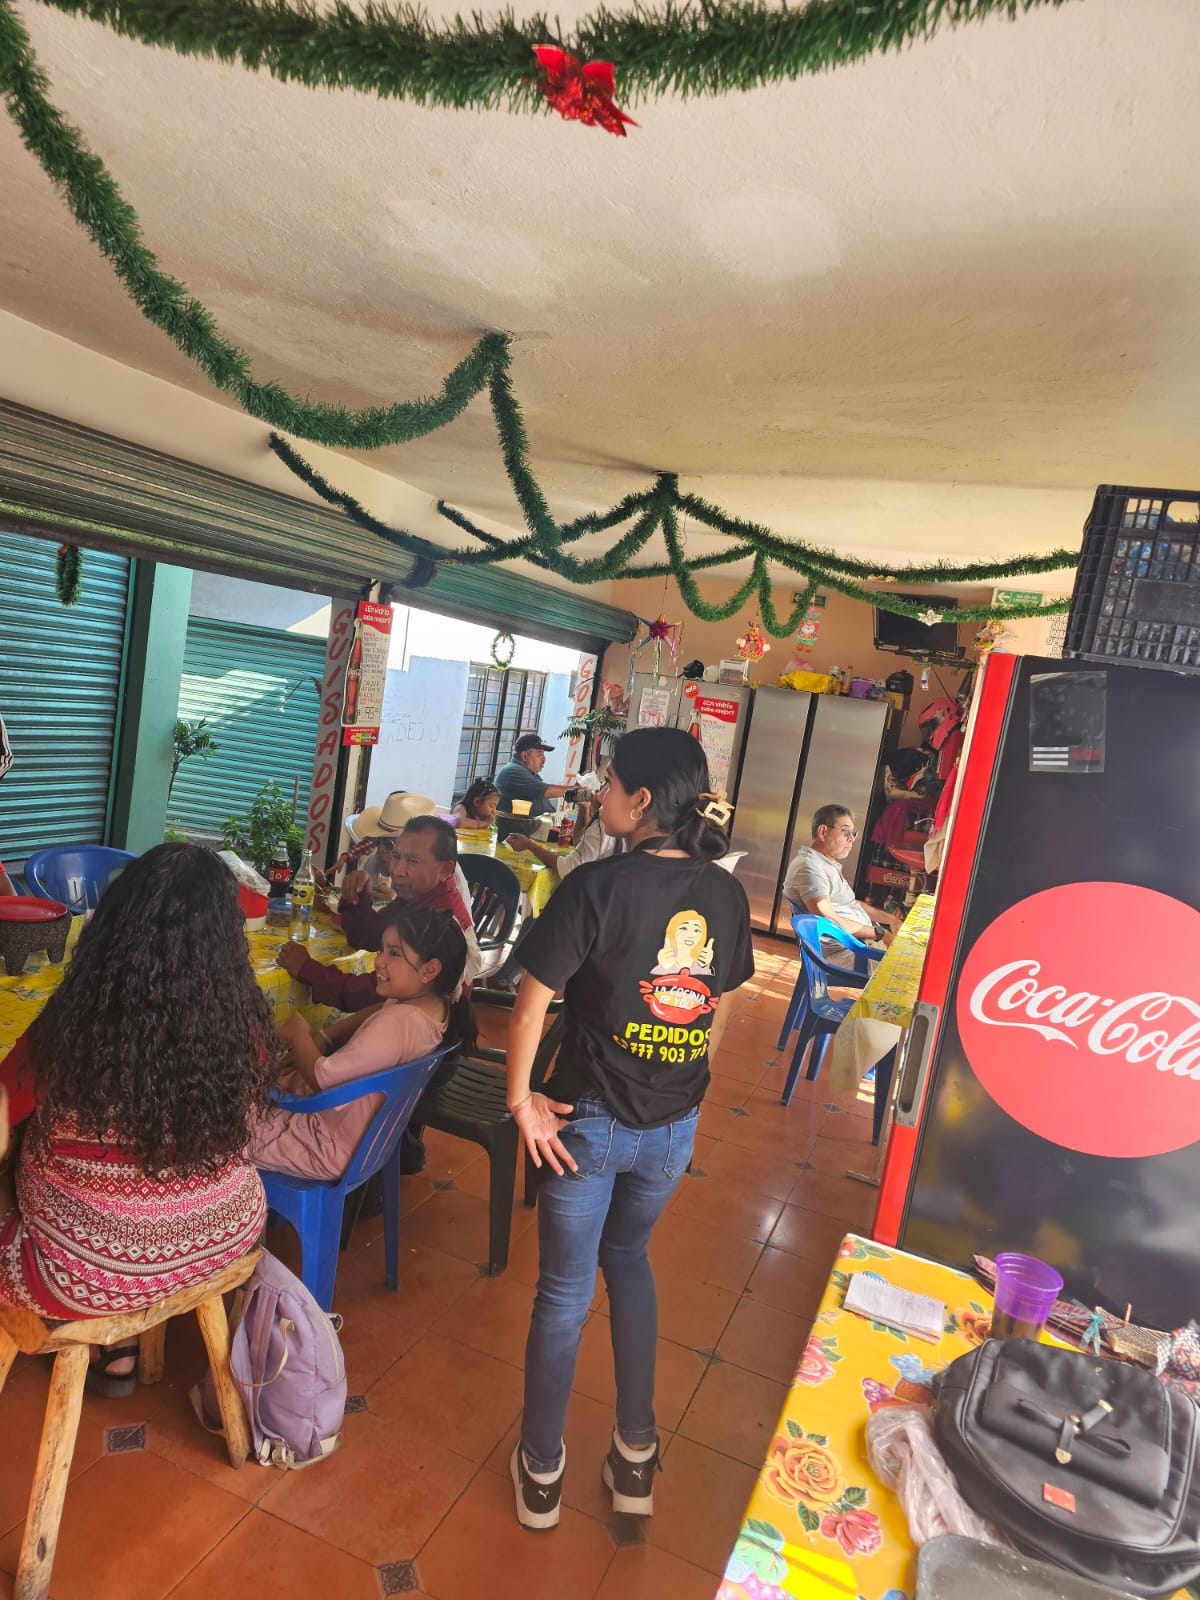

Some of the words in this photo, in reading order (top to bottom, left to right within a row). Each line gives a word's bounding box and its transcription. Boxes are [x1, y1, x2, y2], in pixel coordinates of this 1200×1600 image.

[715, 702, 734, 710] vidrio
[306, 608, 352, 856] GUISADOS
[655, 985, 667, 993] LA
[670, 985, 706, 1004] COCINA
[630, 1042, 654, 1060] 777
[659, 1046, 686, 1063] 903
